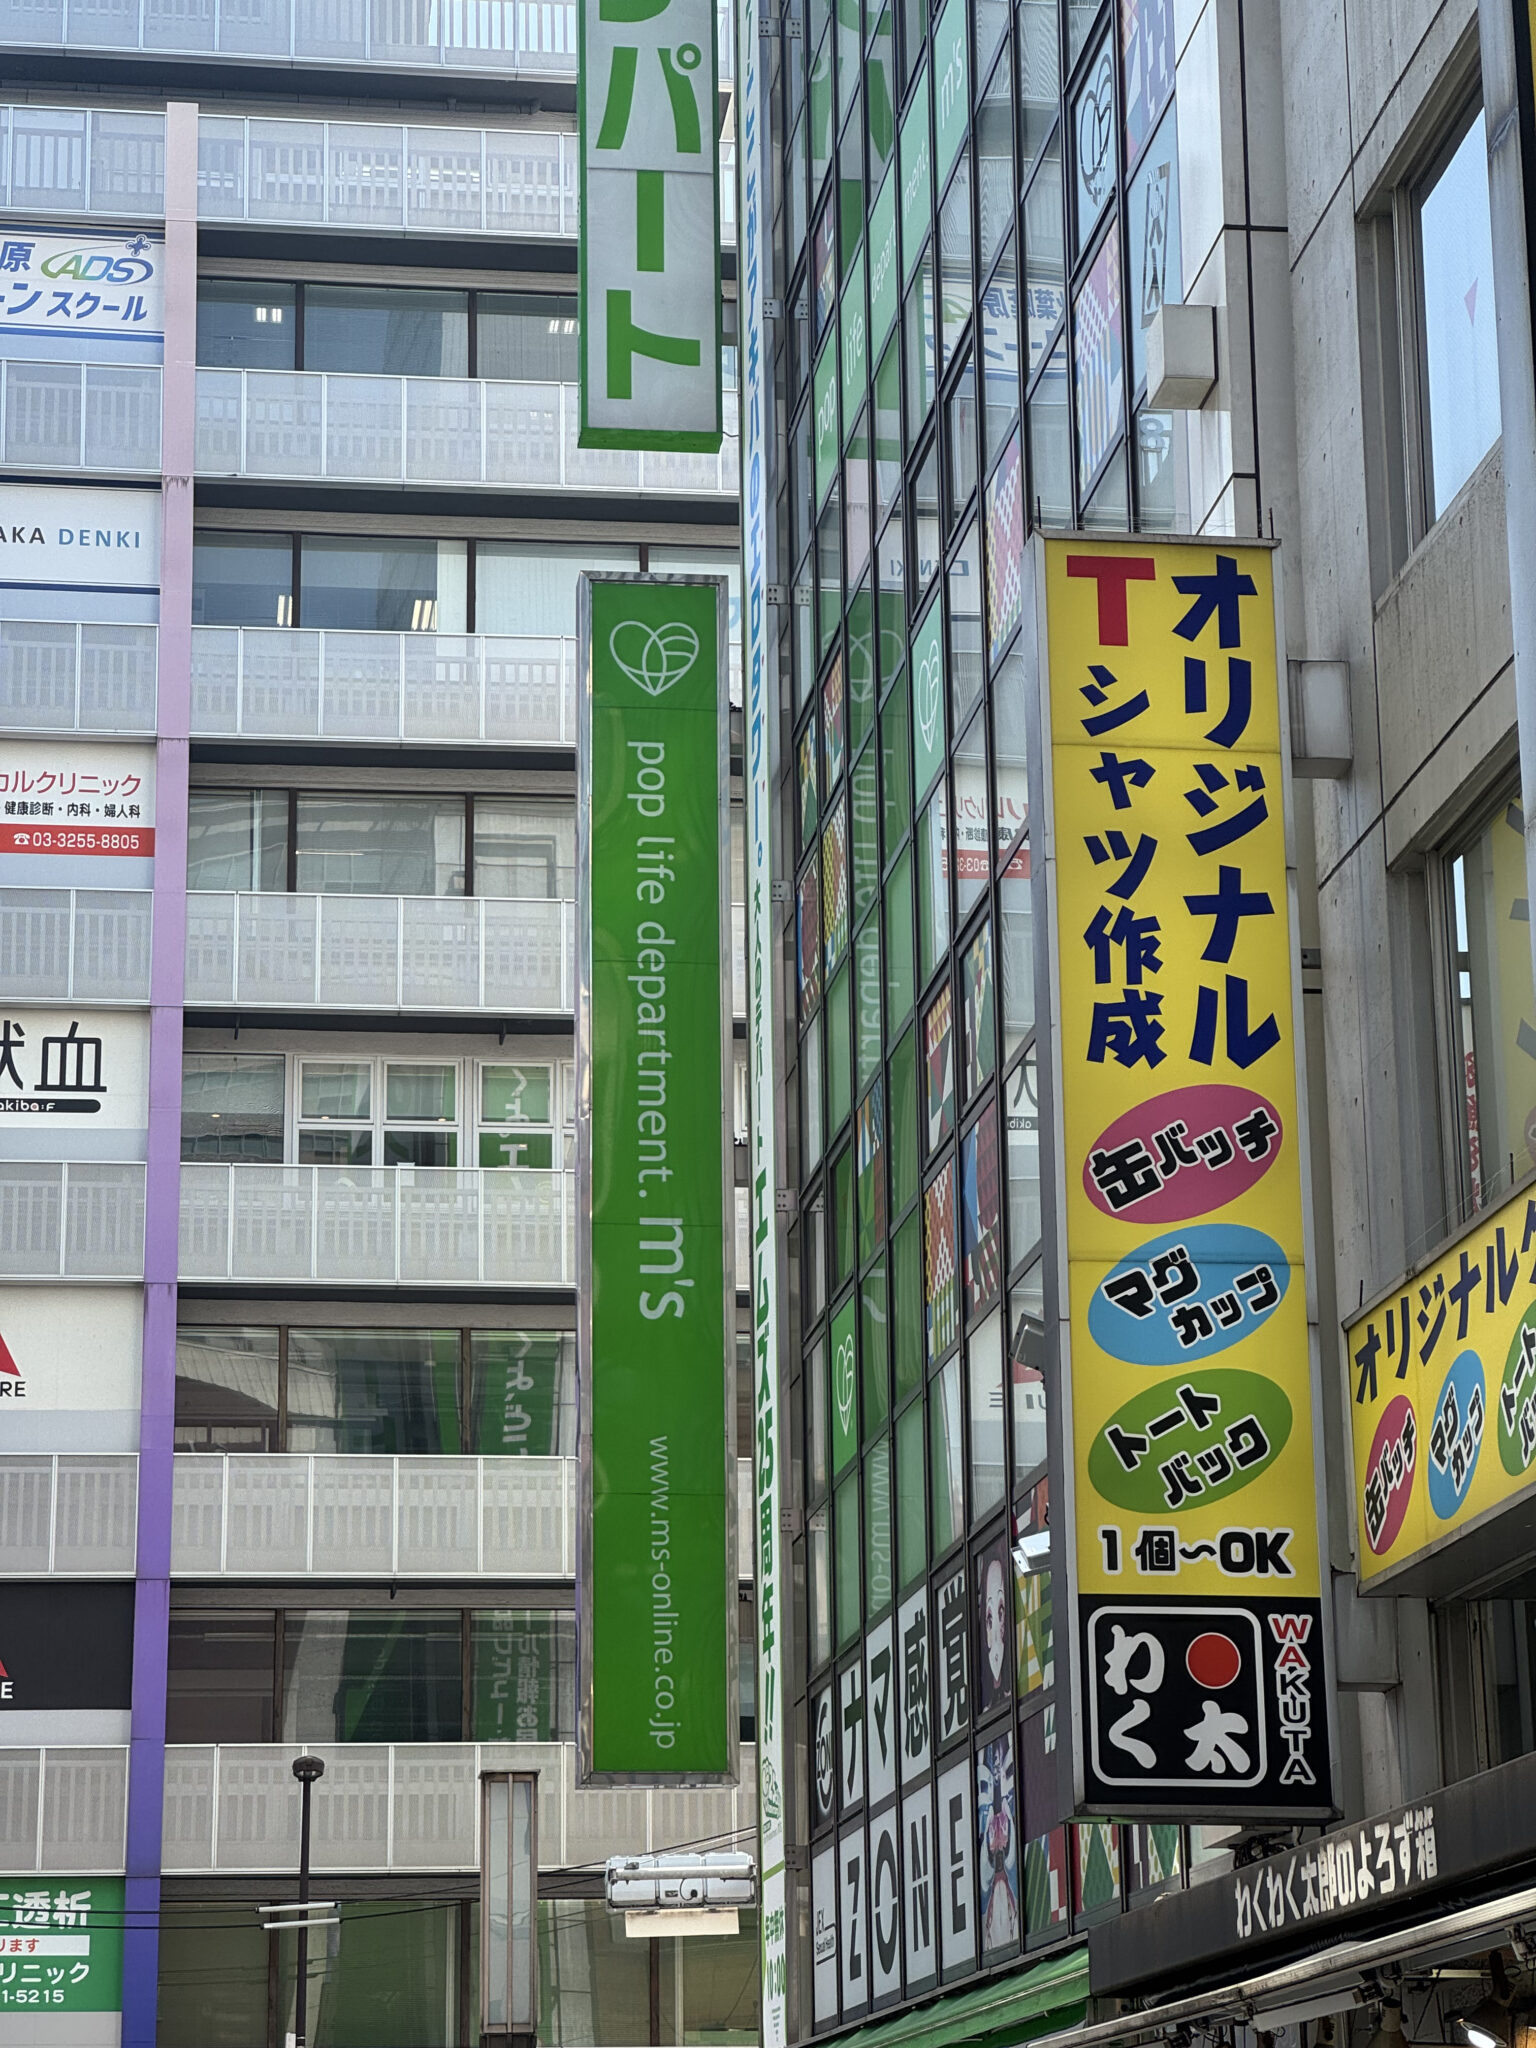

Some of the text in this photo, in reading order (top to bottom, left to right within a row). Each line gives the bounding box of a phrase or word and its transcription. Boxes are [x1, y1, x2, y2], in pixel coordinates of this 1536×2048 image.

[594, 0, 702, 400] パート
[818, 376, 836, 461] pop
[845, 311, 863, 385] life
[941, 36, 963, 130] m's
[0, 241, 138, 284] 原 ADS
[58, 528, 140, 549] DENKI
[4, 800, 141, 819] 健康診断・内科・婦人科
[32, 832, 140, 850] 03-3255-8805
[1066, 554, 1165, 1070] Tシャツ作成
[1171, 554, 1282, 1070] オリジナル
[627, 741, 694, 1320] pop life department. m's
[1090, 1108, 1279, 1212] 缶バッチ
[1102, 1244, 1201, 1319] マグ
[1169, 1264, 1282, 1349] カップ
[0, 1381, 26, 1397] RE
[1107, 1383, 1221, 1472] トート
[1430, 1380, 1459, 1475] マグ
[1451, 1383, 1485, 1497] カップ
[1158, 1414, 1271, 1509] バック
[1364, 1408, 1417, 1550] 缶バッチ
[648, 1435, 681, 1750] www.ms-online.co.jp
[842, 1566, 969, 1801] ナマ感覚
[1268, 1613, 1317, 1785] WAKUTA
[846, 1794, 967, 1979] ZONE
[1235, 1806, 1439, 1939] わくわく太郎のよろず箱
[0, 1961, 90, 1985] リニック
[2, 1989, 65, 2004] 1-5215
